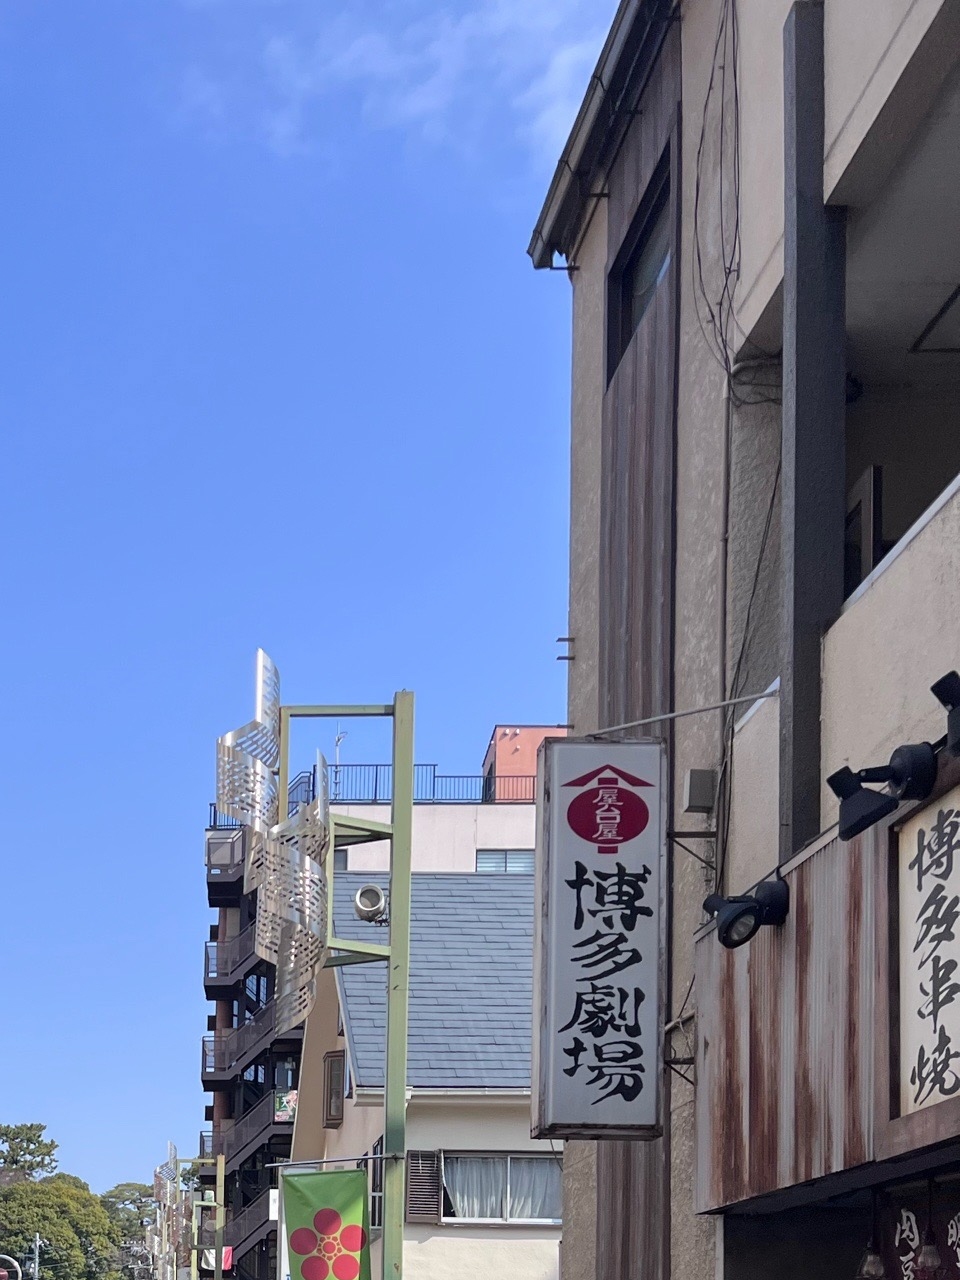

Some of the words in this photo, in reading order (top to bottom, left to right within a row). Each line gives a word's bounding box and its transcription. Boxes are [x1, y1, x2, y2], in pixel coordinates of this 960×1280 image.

[592, 787, 624, 842] 屋台屋
[558, 860, 654, 1105] 博多劇場
